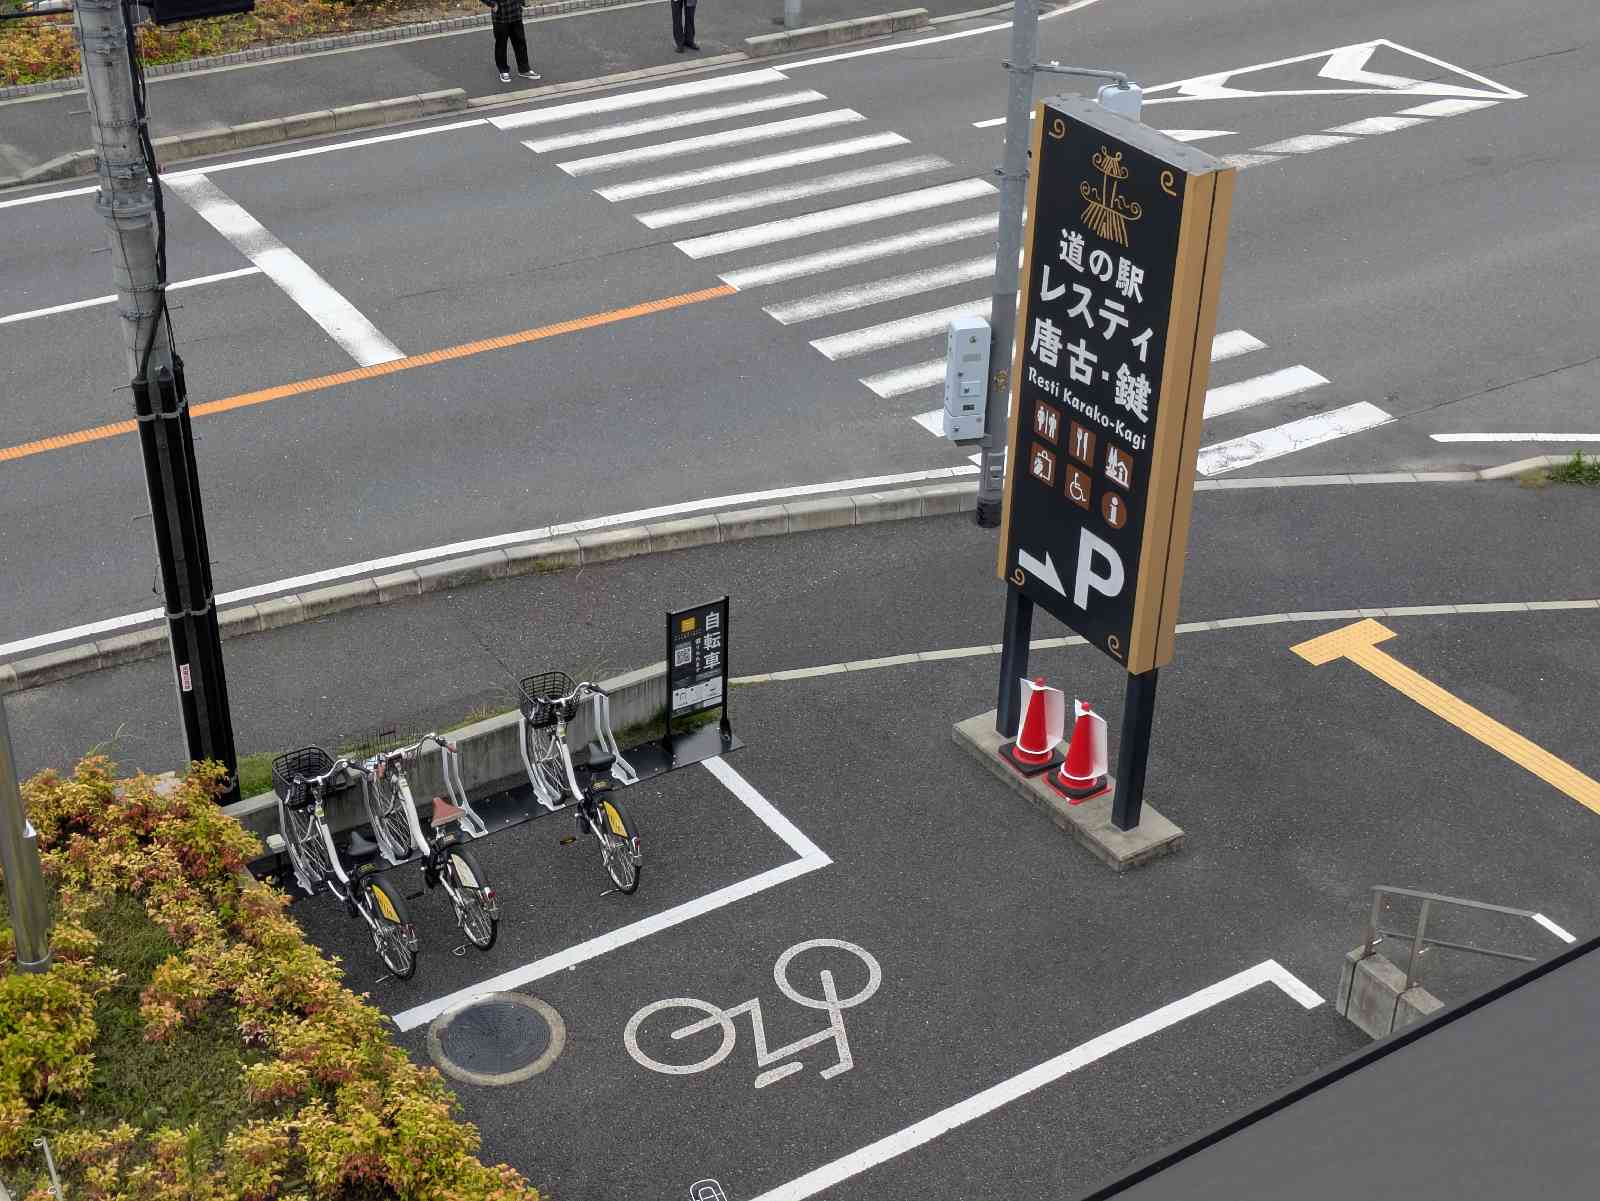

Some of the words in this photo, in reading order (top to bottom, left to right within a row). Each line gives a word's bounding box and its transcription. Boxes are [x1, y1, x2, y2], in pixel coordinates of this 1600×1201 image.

[1059, 227, 1145, 305] 道の駅
[1039, 264, 1153, 363] レスティ
[1028, 366, 1059, 398] Resti
[1063, 386, 1147, 451] Karako-Kagi
[1030, 317, 1152, 425] 唐古・鍵
[1073, 526, 1125, 611] P
[703, 611, 721, 670] 自転車
